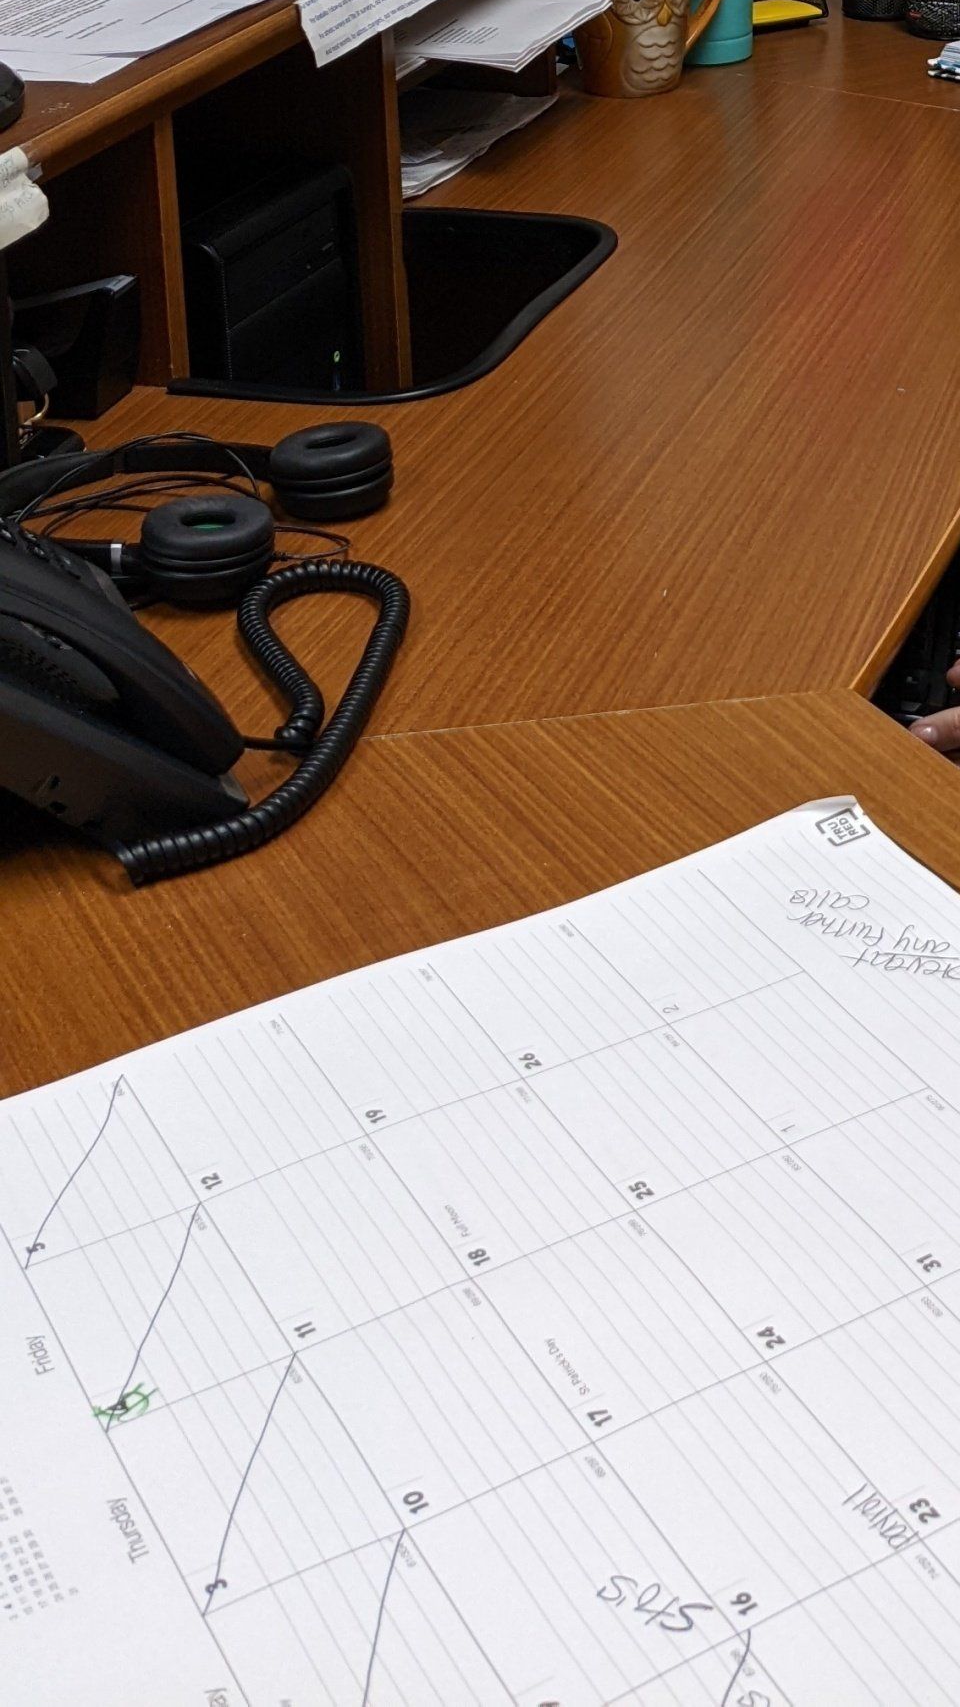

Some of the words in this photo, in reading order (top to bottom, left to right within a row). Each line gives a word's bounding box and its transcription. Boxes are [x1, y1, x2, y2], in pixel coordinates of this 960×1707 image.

[827, 821, 848, 840] TRU
[838, 817, 859, 836] RED
[789, 889, 870, 910] calls
[518, 1051, 544, 1071] 26
[364, 1107, 389, 1127] 19
[199, 1171, 225, 1193] 12
[628, 1179, 656, 1201] 25
[466, 1246, 492, 1268] 18
[915, 1252, 943, 1275] 31
[292, 1320, 319, 1342] 11
[756, 1325, 787, 1351] 24
[25, 1334, 57, 1378] Friday
[586, 1408, 613, 1428] 17
[400, 1489, 431, 1516] 10
[908, 1496, 942, 1525] 23
[105, 1495, 153, 1566] Thursday
[730, 1591, 759, 1617] 16
